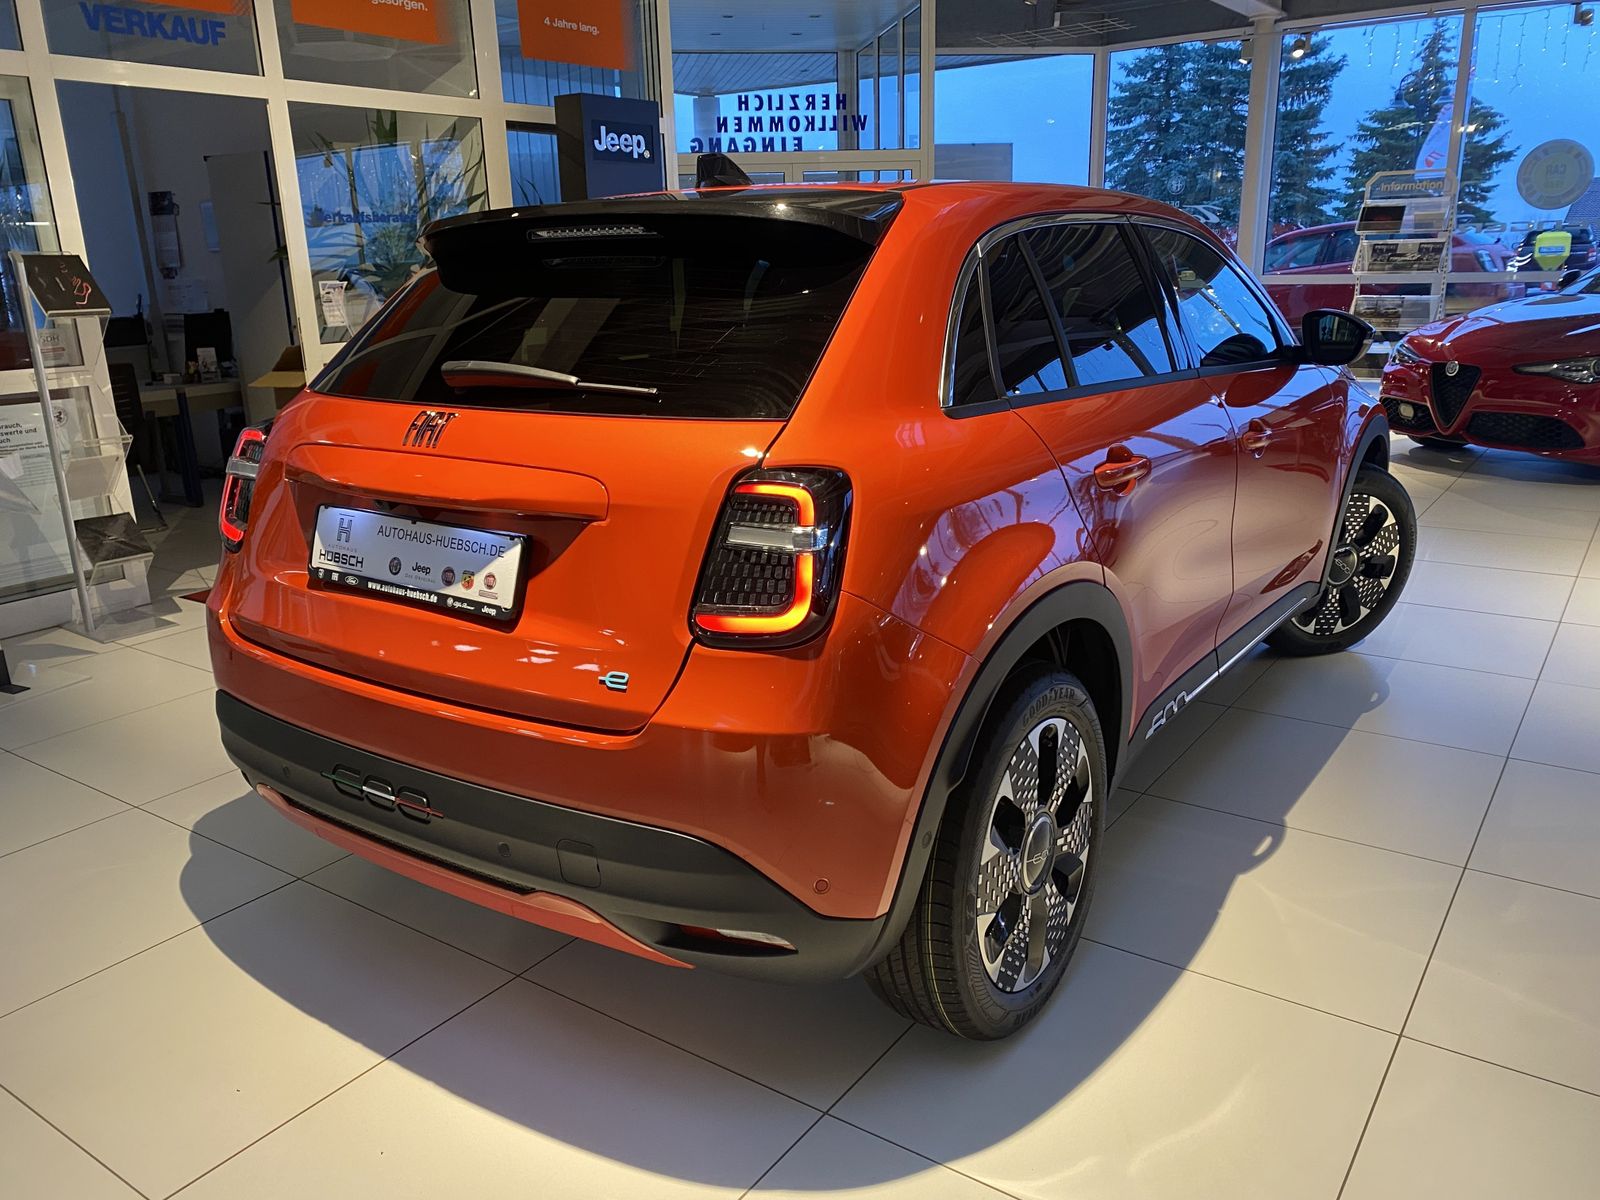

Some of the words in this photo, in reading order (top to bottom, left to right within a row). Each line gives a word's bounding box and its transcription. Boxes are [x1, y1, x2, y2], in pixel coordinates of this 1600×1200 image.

[79, 2, 226, 46] VERKAUF
[543, 17, 551, 26] 4
[552, 18, 578, 31] Jahre
[579, 22, 600, 36] lang.
[593, 125, 646, 159] Jeep
[1380, 181, 1444, 193] Information
[402, 410, 459, 449] FIAT
[377, 525, 506, 558] AUTOHAUS-HUEBSCH.DE
[411, 562, 431, 576] Jeep
